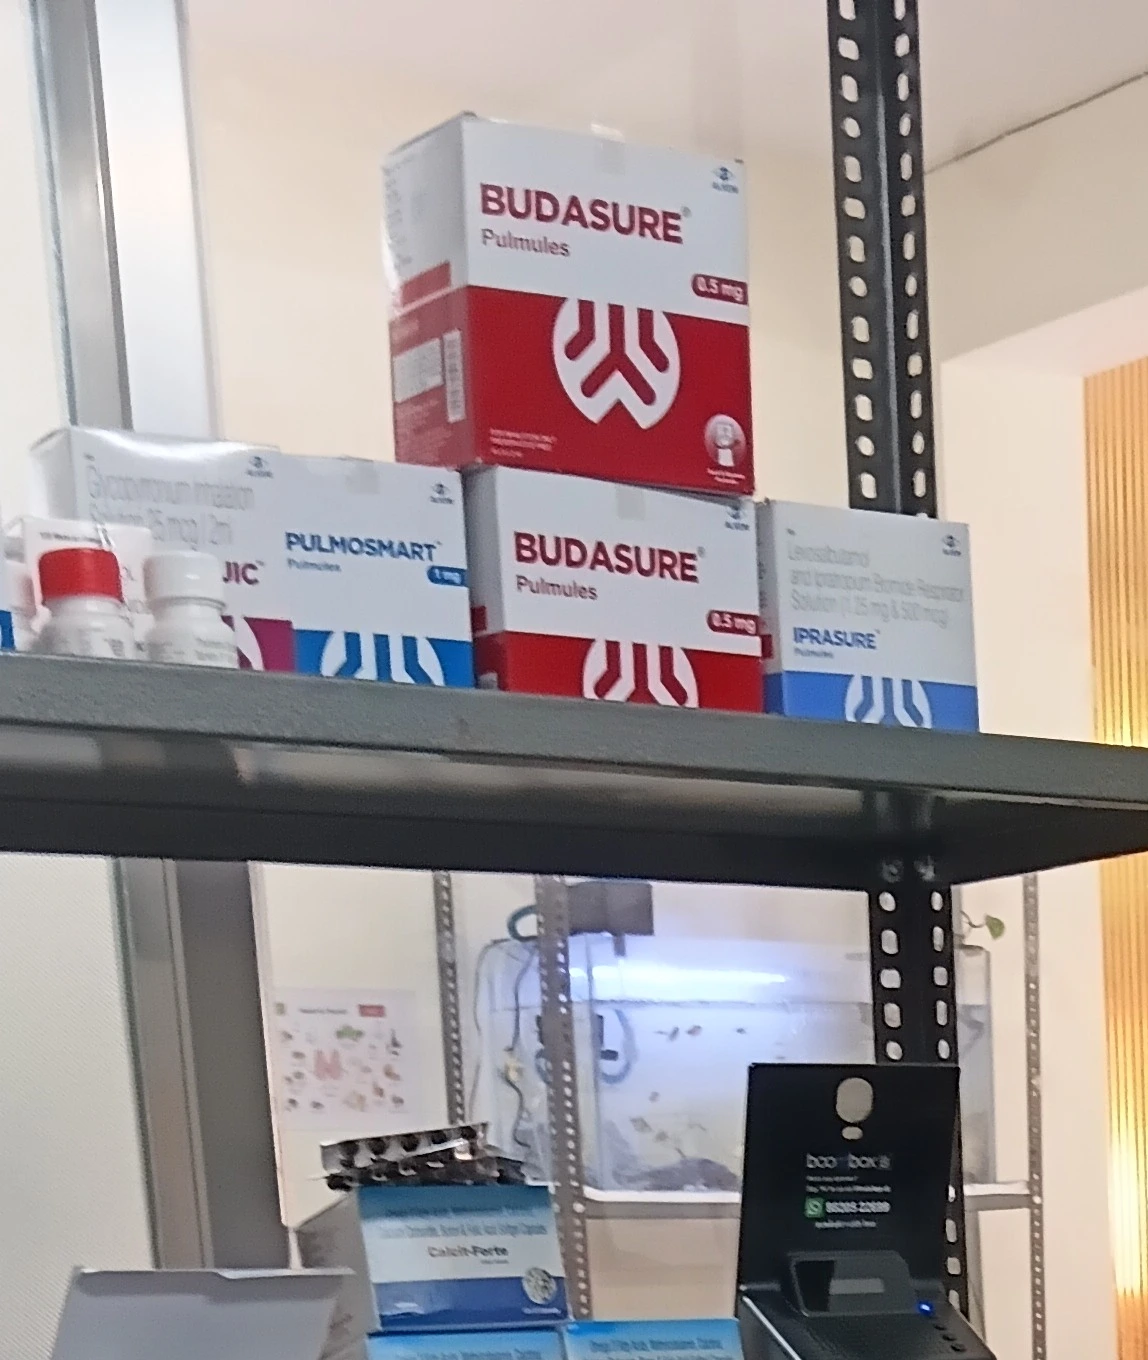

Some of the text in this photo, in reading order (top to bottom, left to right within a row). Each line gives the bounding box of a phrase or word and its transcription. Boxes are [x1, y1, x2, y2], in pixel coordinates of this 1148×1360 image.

[480, 182, 684, 245] BUDASURE
[481, 228, 571, 257] Pulmules
[722, 281, 746, 300] mg
[286, 531, 436, 562] PULMOSMART
[514, 532, 700, 583] BUDASURE
[516, 575, 599, 600] Pulmules
[736, 617, 759, 636] mg
[793, 627, 877, 650] IPRASURE
